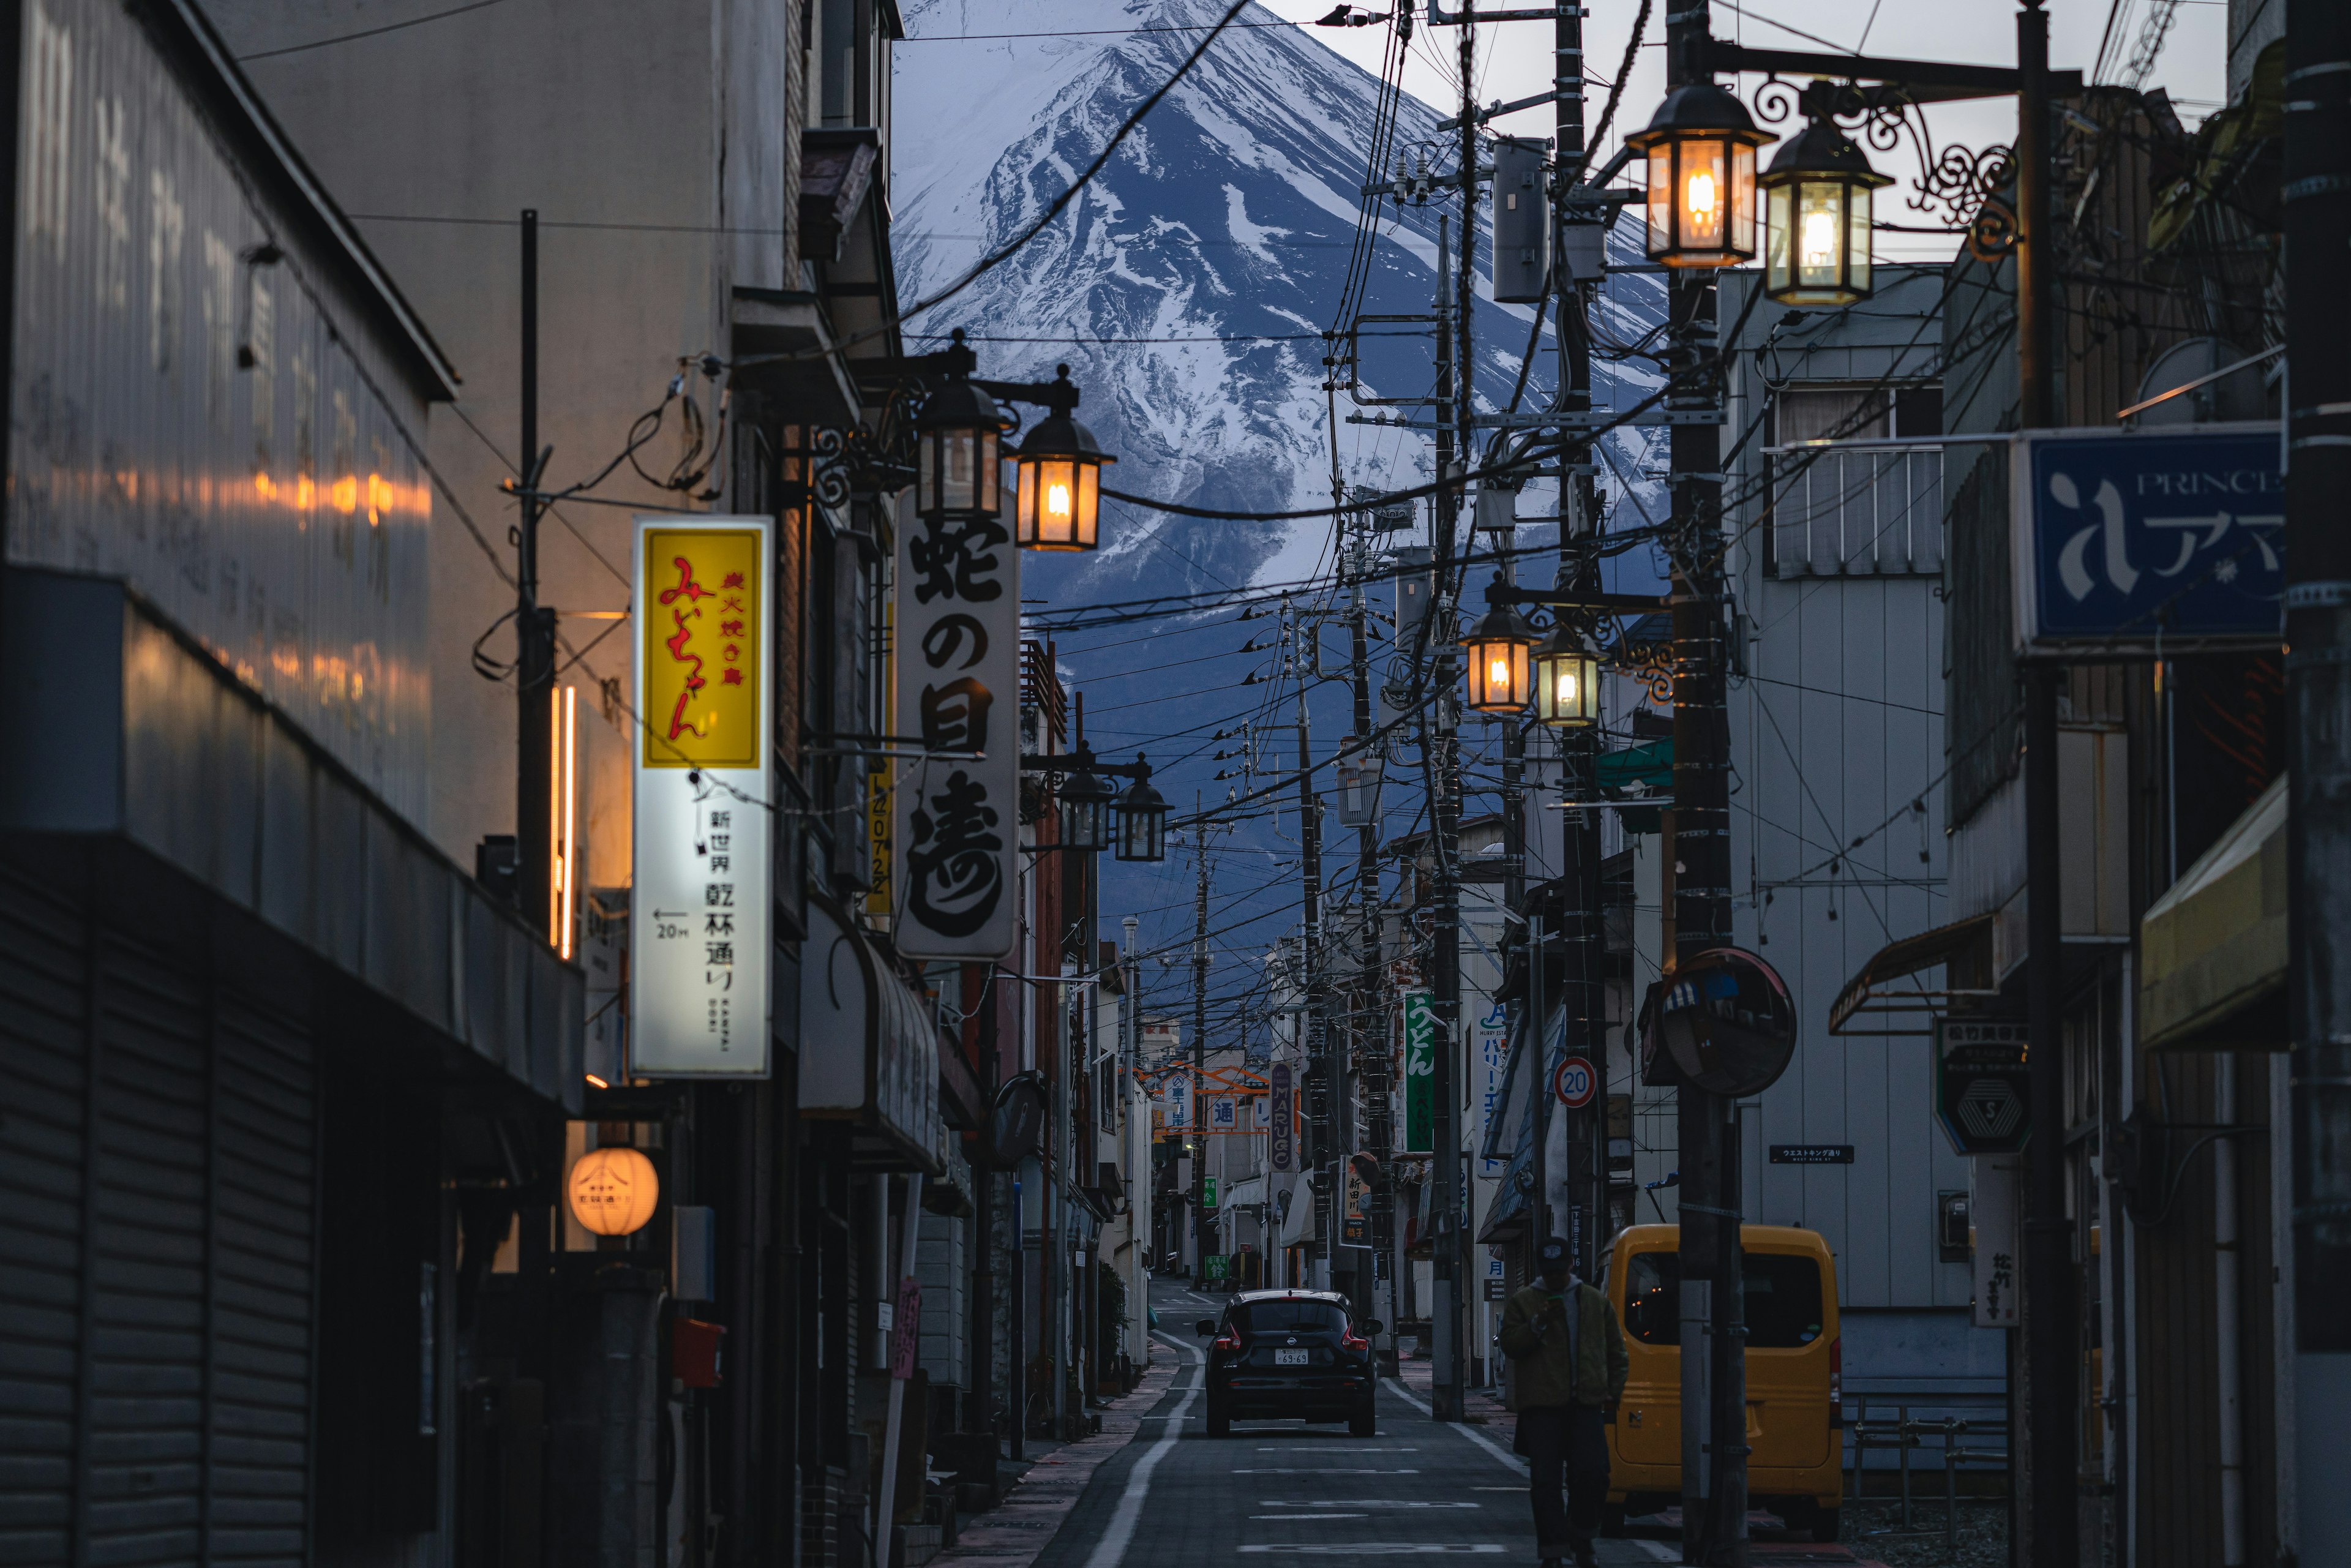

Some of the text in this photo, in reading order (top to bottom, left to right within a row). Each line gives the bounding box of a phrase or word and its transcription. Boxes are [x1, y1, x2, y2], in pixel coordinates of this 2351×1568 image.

[1408, 997, 1434, 1076] うどん
[1564, 1071, 1587, 1094] 20
[1349, 1177, 1362, 1212] 新田川
